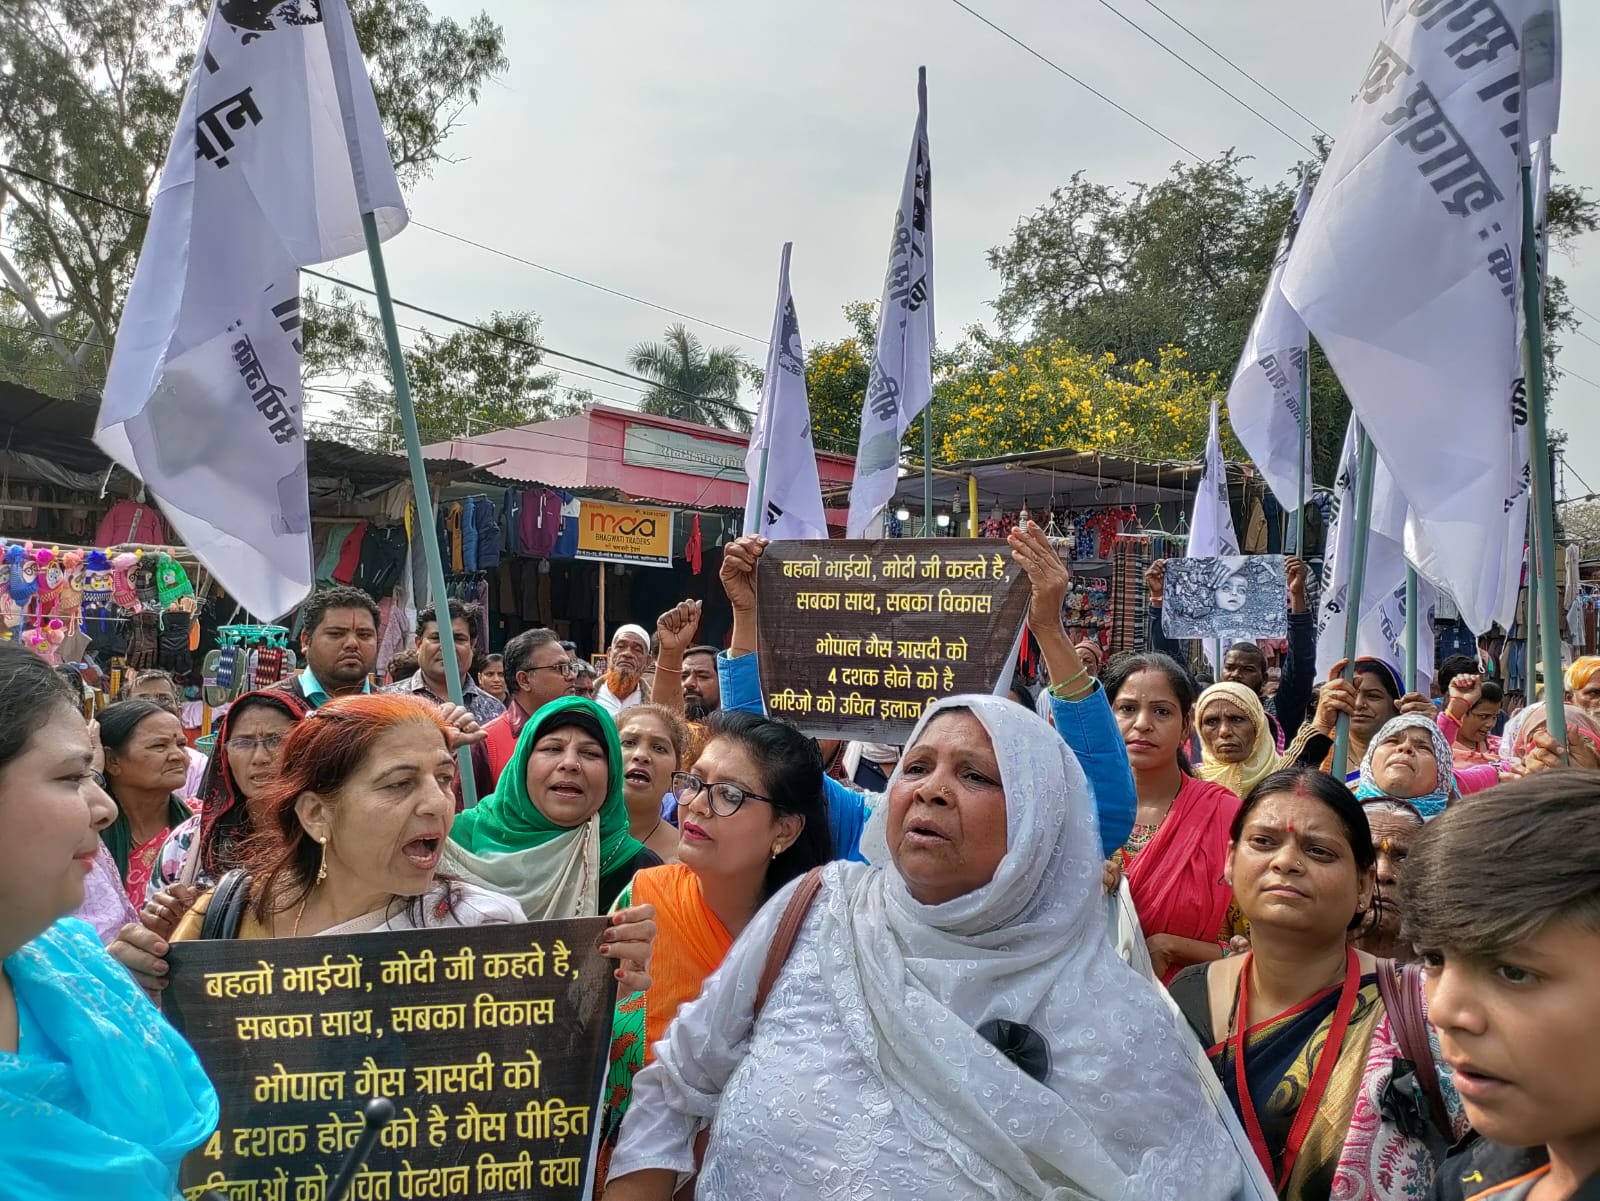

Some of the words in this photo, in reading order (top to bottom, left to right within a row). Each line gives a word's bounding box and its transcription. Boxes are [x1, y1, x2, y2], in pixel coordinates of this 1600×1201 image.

[595, 533, 624, 544] BHAGWATI
[625, 536, 651, 546] TRADERS
[783, 555, 821, 577] बहनों
[826, 554, 877, 582] भाईयों,
[882, 554, 916, 578] मोदी
[920, 554, 940, 579] जी
[946, 554, 991, 580] कहते
[992, 554, 1010, 583] है,
[796, 592, 840, 611] सबका
[844, 592, 881, 615] साथ,
[886, 592, 932, 612] सबका
[938, 588, 992, 614] विकास
[816, 632, 861, 657] भोपाल
[866, 633, 892, 658] गैस
[897, 636, 940, 661] त्रासदी
[946, 637, 968, 661] को
[828, 668, 837, 684] 4
[842, 668, 880, 686] दशक
[884, 665, 912, 689] होने
[916, 666, 938, 690] को
[942, 666, 955, 692] है
[816, 690, 836, 714] को
[840, 691, 876, 716] उचित
[880, 696, 922, 720] इलाज
[204, 960, 274, 998] बहनों
[283, 954, 373, 996] भाईयों,
[381, 949, 437, 985] मोदी
[443, 946, 476, 981] जी
[483, 942, 545, 979] कहते
[552, 940, 579, 980] है,
[236, 1014, 312, 1040] सबका
[320, 1009, 384, 1038] साथ,
[391, 1003, 466, 1033] सबका
[474, 993, 555, 1029] विकास
[255, 1063, 346, 1104] भोपाल
[354, 1056, 406, 1097] गैस
[414, 1052, 495, 1094] त्रासदी
[502, 1050, 542, 1090] को
[204, 1130, 223, 1160] 4
[233, 1124, 309, 1158] दशक
[380, 1108, 420, 1149] को
[427, 1104, 449, 1148] है
[456, 1102, 507, 1143] गैस
[515, 1098, 590, 1144] पीड़ित
[294, 1164, 328, 1201] को
[398, 1160, 470, 1200] पेन्शन
[477, 1150, 534, 1195] मिली
[539, 1158, 582, 1188] क्या
